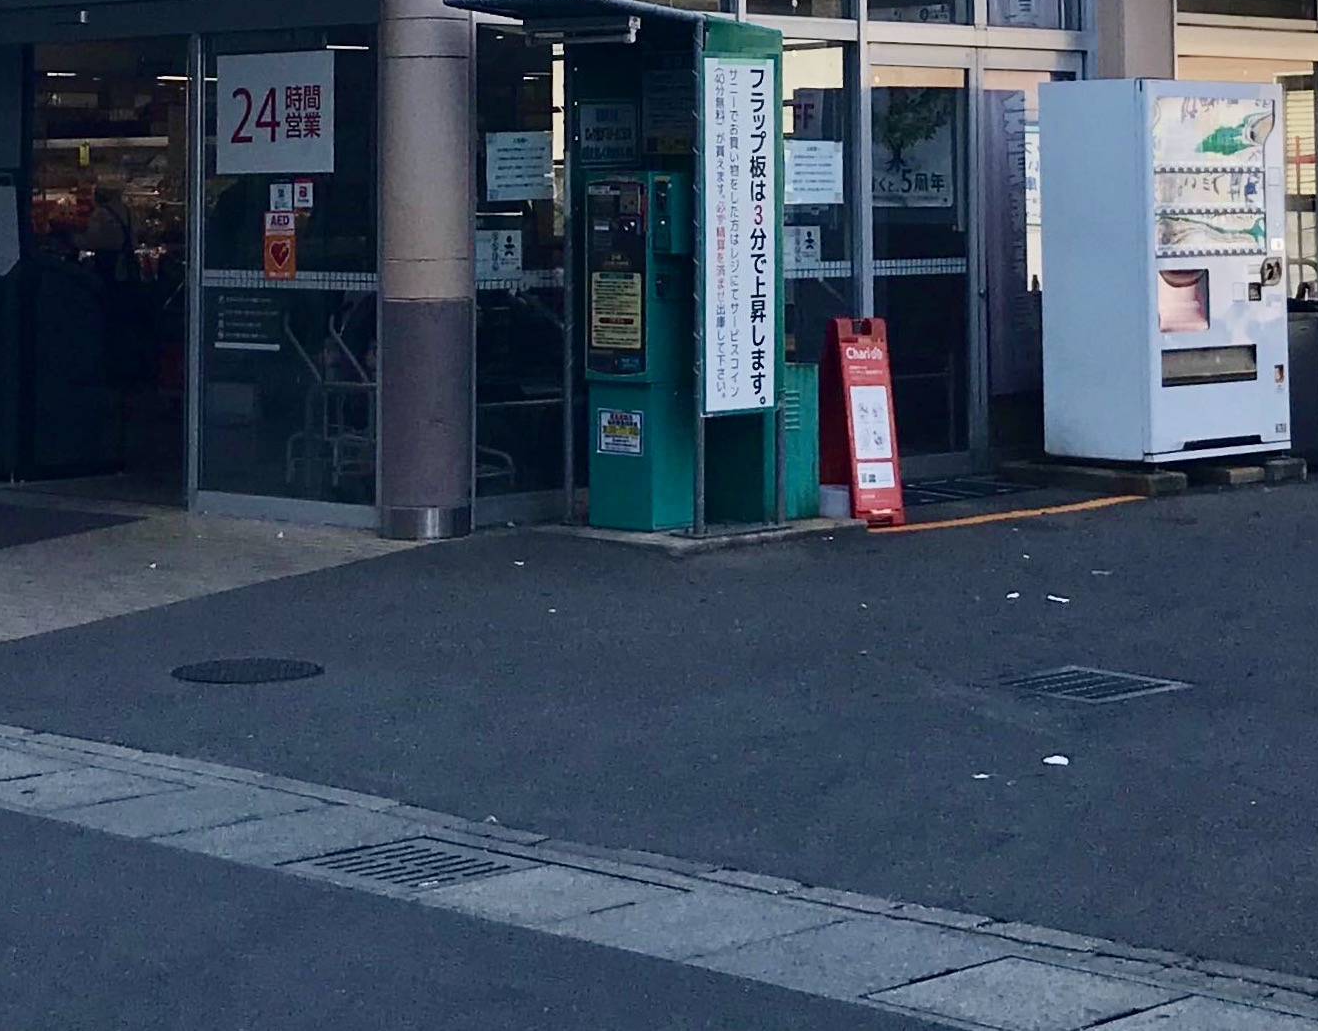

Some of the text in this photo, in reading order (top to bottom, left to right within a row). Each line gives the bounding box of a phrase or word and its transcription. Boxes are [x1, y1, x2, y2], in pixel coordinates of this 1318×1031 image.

[284, 84, 322, 112] 時間
[230, 86, 282, 144] 24
[284, 112, 322, 140] 営業
[270, 215, 290, 227] AED
